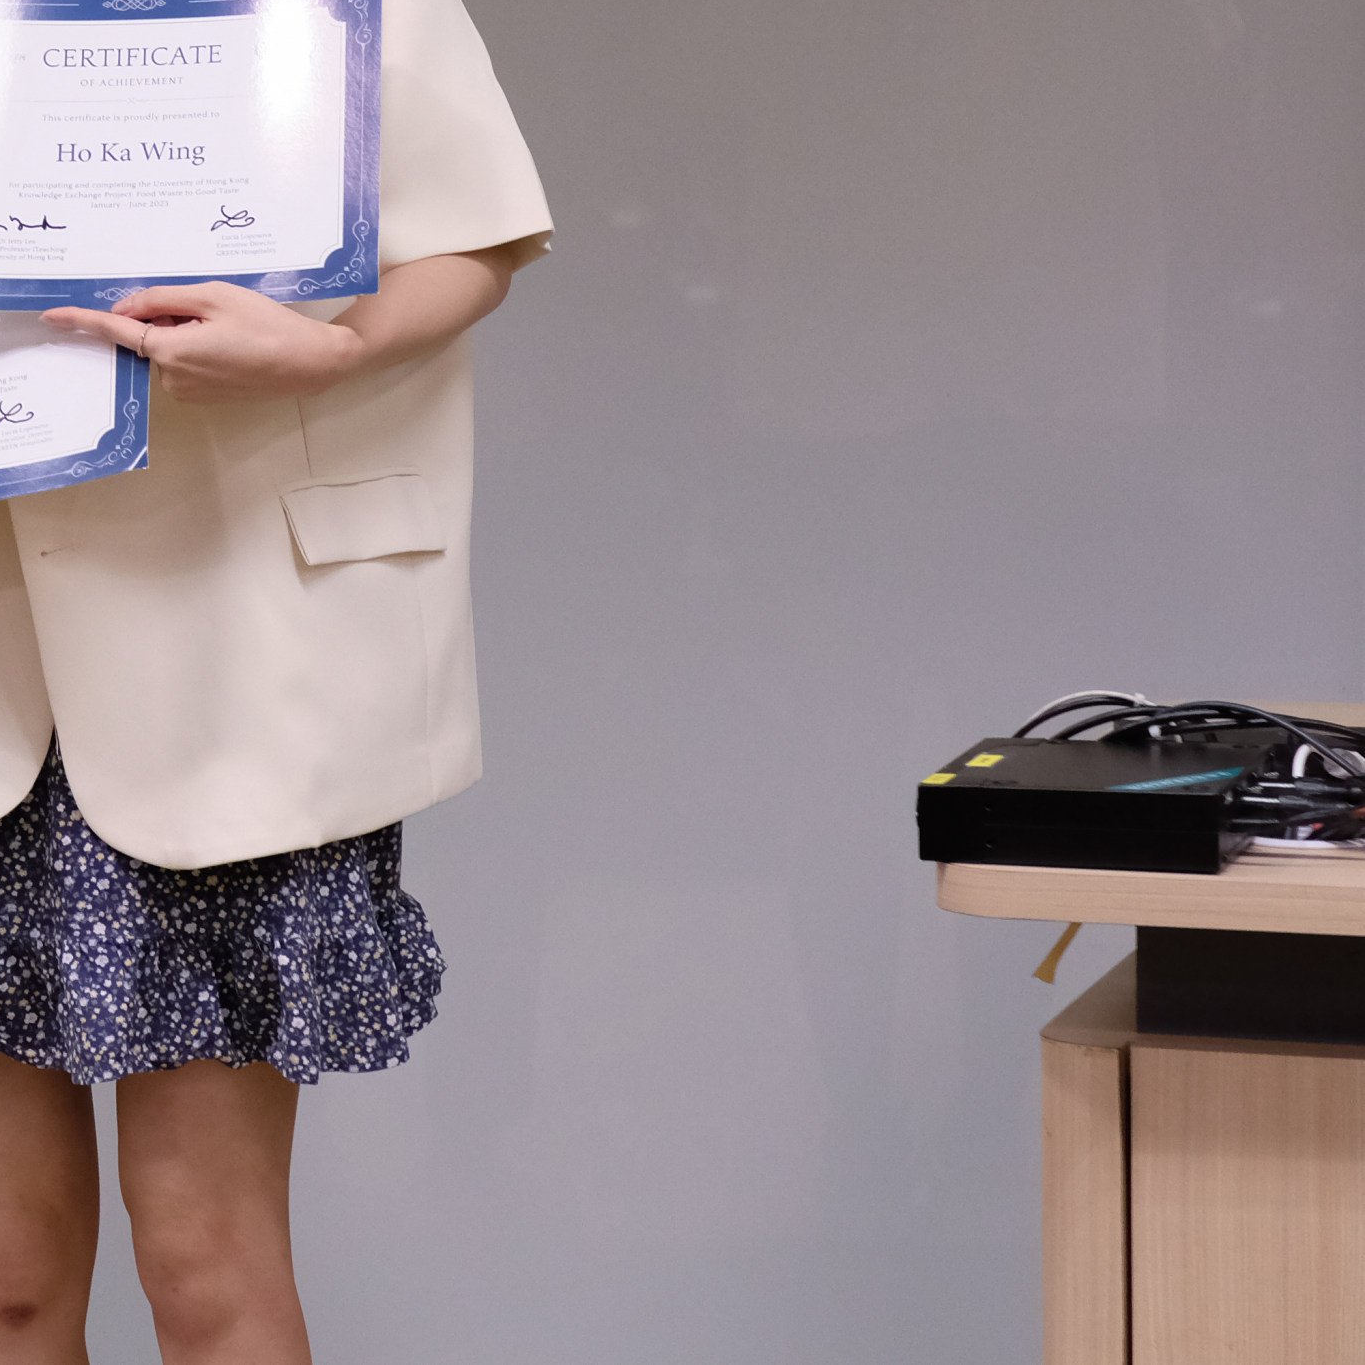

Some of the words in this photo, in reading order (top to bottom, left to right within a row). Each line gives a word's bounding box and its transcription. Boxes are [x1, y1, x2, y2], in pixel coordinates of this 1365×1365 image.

[42, 43, 222, 69] CERTIFICATE
[79, 78, 96, 87] OF
[98, 76, 184, 87] ACHIEVEMENT
[42, 114, 62, 122] This
[64, 113, 111, 122] certificate
[123, 112, 160, 123] proudly
[162, 110, 208, 122] presented
[55, 141, 92, 163] Ho
[100, 141, 132, 163] Ka
[140, 140, 206, 166] Wing
